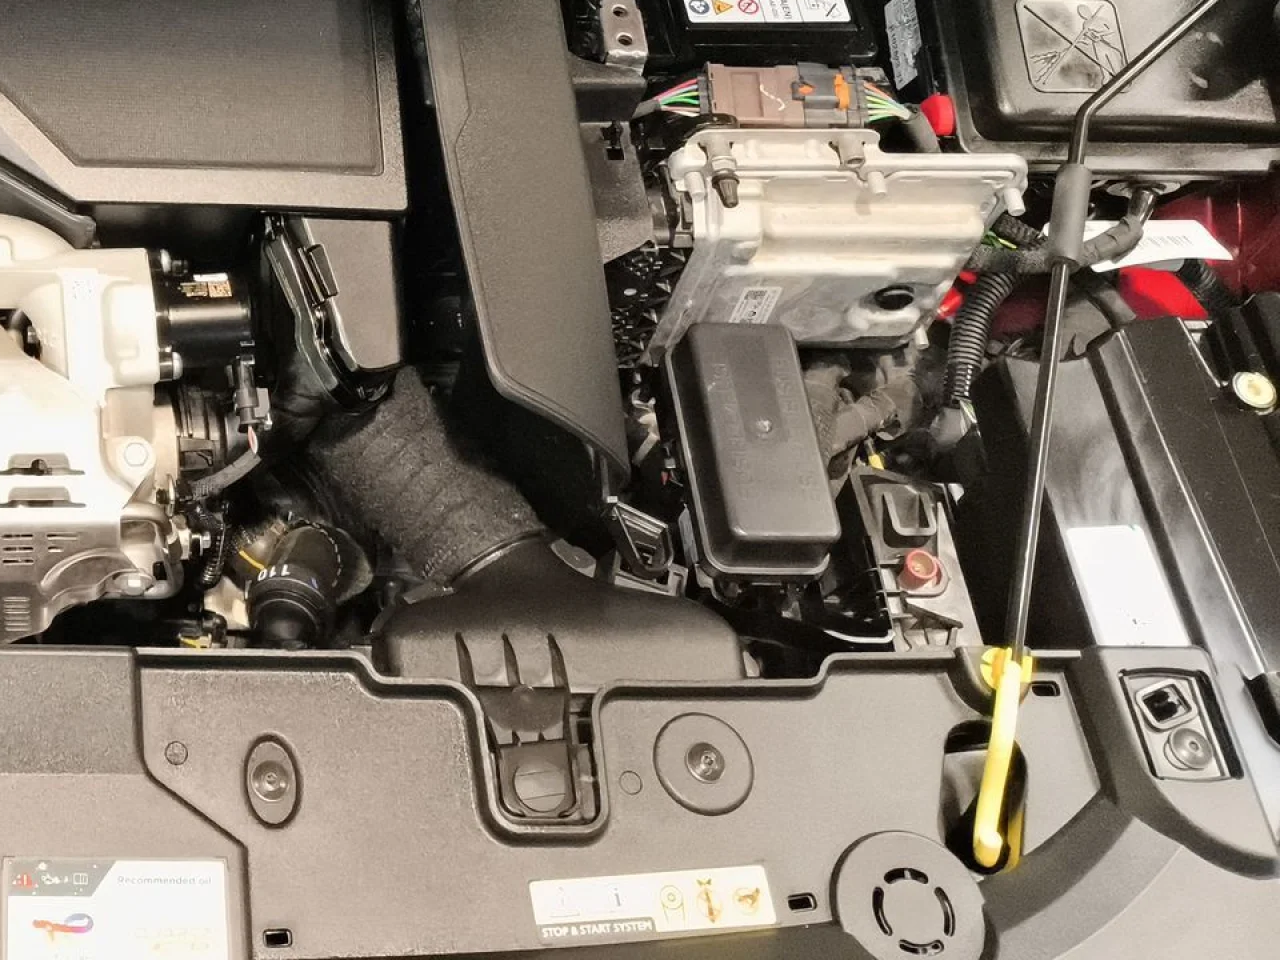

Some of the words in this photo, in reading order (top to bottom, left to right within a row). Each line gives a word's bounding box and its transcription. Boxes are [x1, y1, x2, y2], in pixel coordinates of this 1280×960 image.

[257, 563, 291, 582] 110
[116, 874, 197, 886] Recommended
[199, 876, 212, 887] oil
[542, 926, 569, 938] STOP
[571, 926, 578, 936] &
[580, 923, 611, 935] START
[613, 920, 652, 933] SYSTEM
